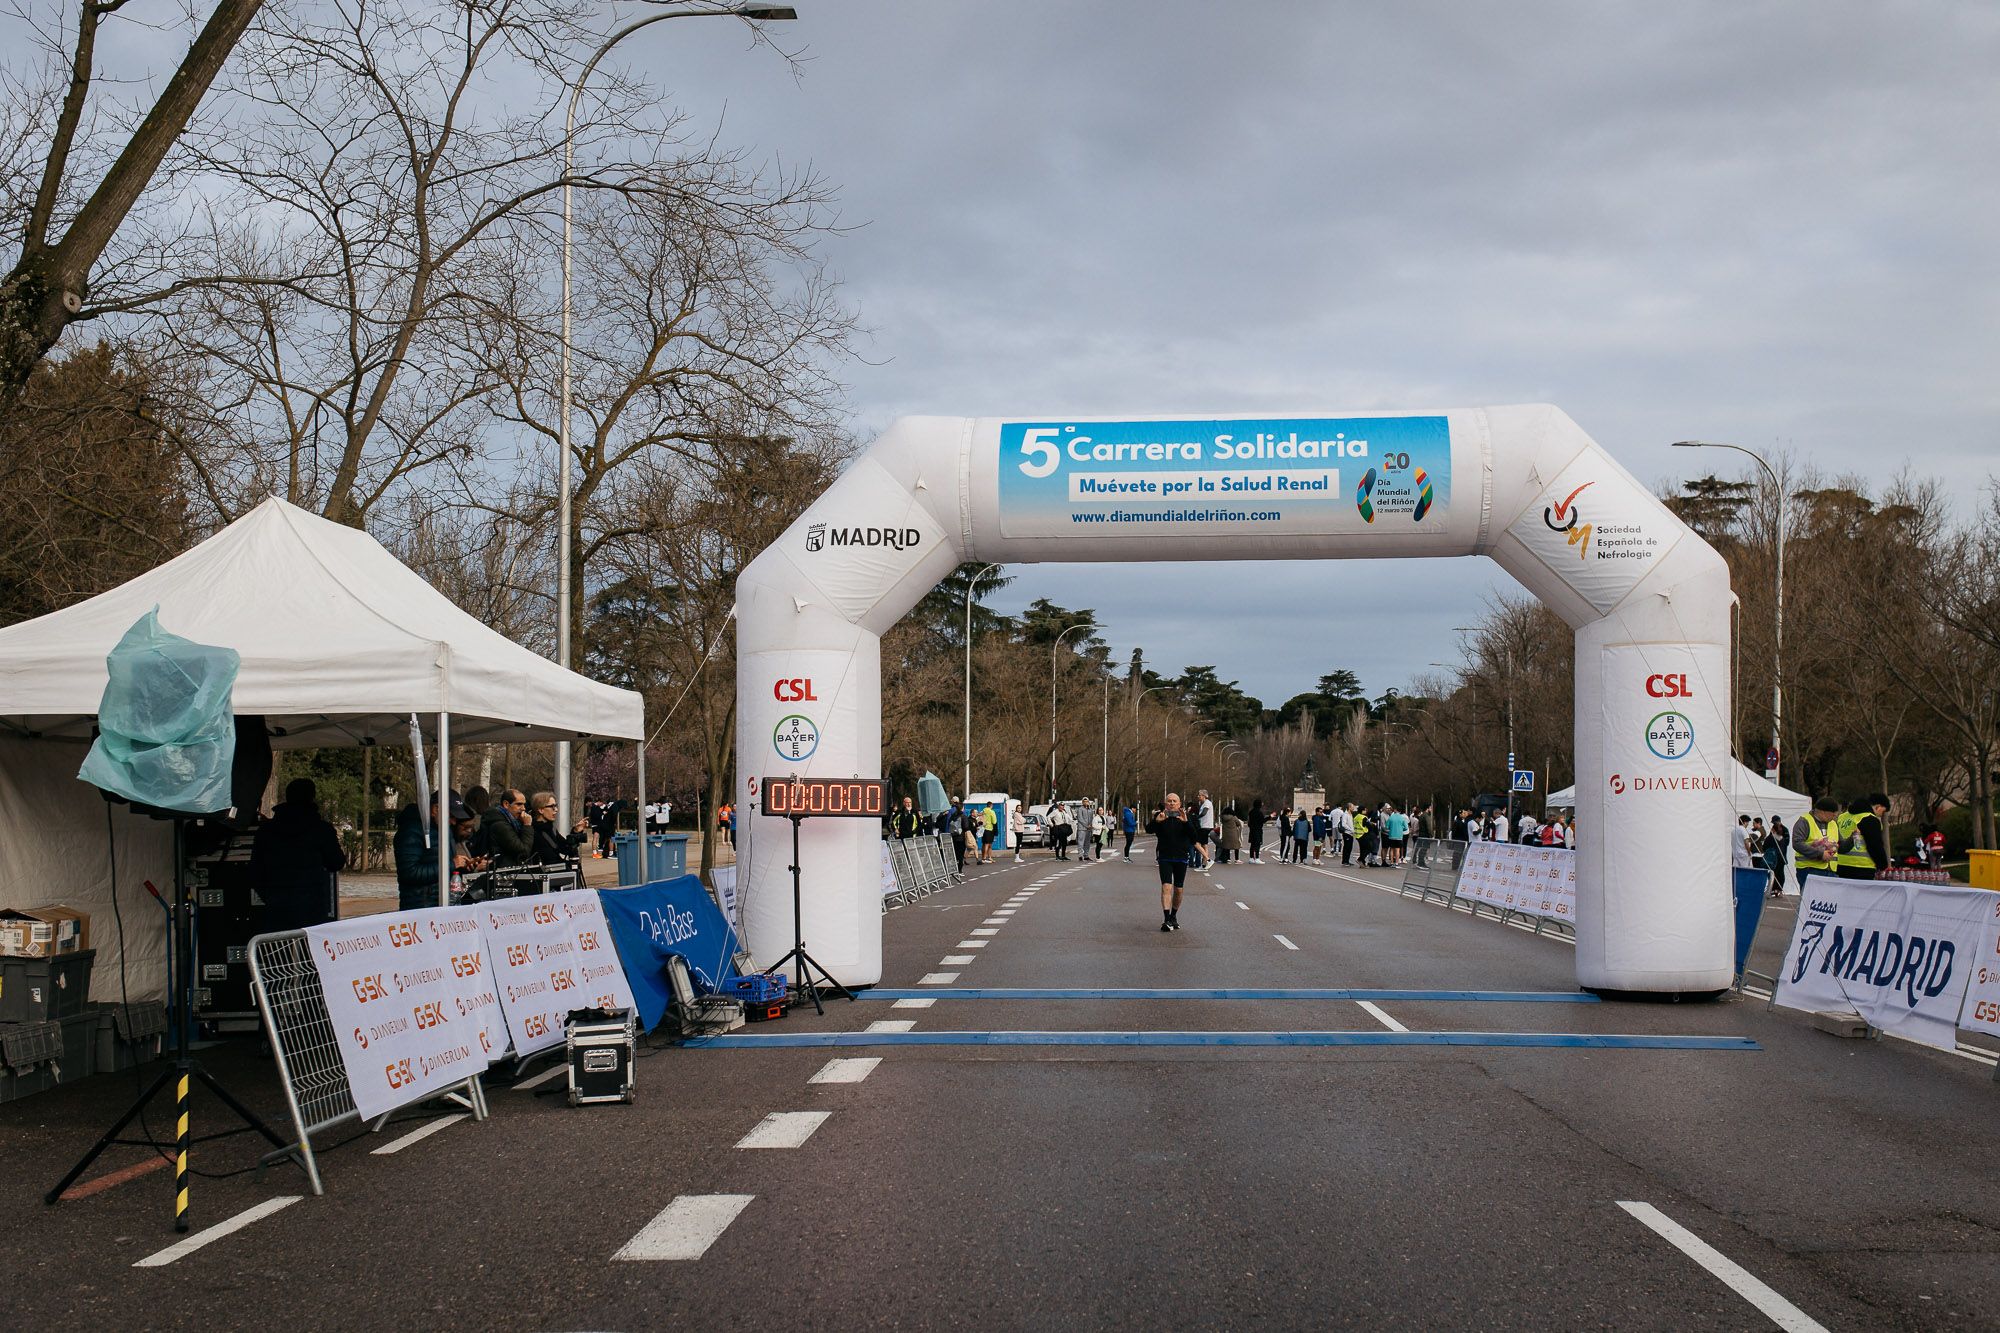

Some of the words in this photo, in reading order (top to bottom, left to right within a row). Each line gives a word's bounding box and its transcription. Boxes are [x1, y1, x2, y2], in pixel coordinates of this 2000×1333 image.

[1067, 436, 1202, 462] Carrera
[1213, 432, 1368, 460] Solidaria
[1383, 453, 1409, 471] 20
[1079, 478, 1157, 493] Muévete
[1162, 483, 1193, 496] por
[1198, 477, 1215, 491] la
[1220, 475, 1272, 491] Salud
[1277, 475, 1328, 490] Renal
[1072, 509, 1281, 523] www.diamundialdelriñon.com
[830, 527, 921, 551] MADRID
[1597, 525, 1641, 534] Sociedad
[1597, 537, 1642, 548] Española
[1646, 537, 1658, 546] de
[774, 678, 818, 702] CSL
[1645, 674, 1693, 698] CSL
[777, 734, 815, 742] BAYER
[792, 719, 800, 757] BAYER
[1667, 716, 1675, 755] BAYER
[1634, 777, 1722, 790] DIAVERUM
[533, 904, 559, 924] GSK
[667, 904, 698, 942] Base
[336, 935, 382, 956] DIAVERUM
[388, 921, 423, 948] GSK
[439, 919, 479, 935] DIAVERUM
[507, 943, 532, 967] GSK
[579, 931, 600, 951] GSK
[352, 973, 388, 1004] GSK
[404, 968, 445, 988] DIAVERUM
[451, 952, 482, 978] GSK
[1820, 925, 1955, 1008] MADRID
[550, 969, 576, 992] GSK
[370, 1017, 409, 1041] DIAVERUM
[413, 1001, 448, 1030] GSK
[524, 1013, 550, 1038] GSK
[385, 1057, 416, 1089] GSK
[428, 1045, 470, 1070] DIAVERUM
